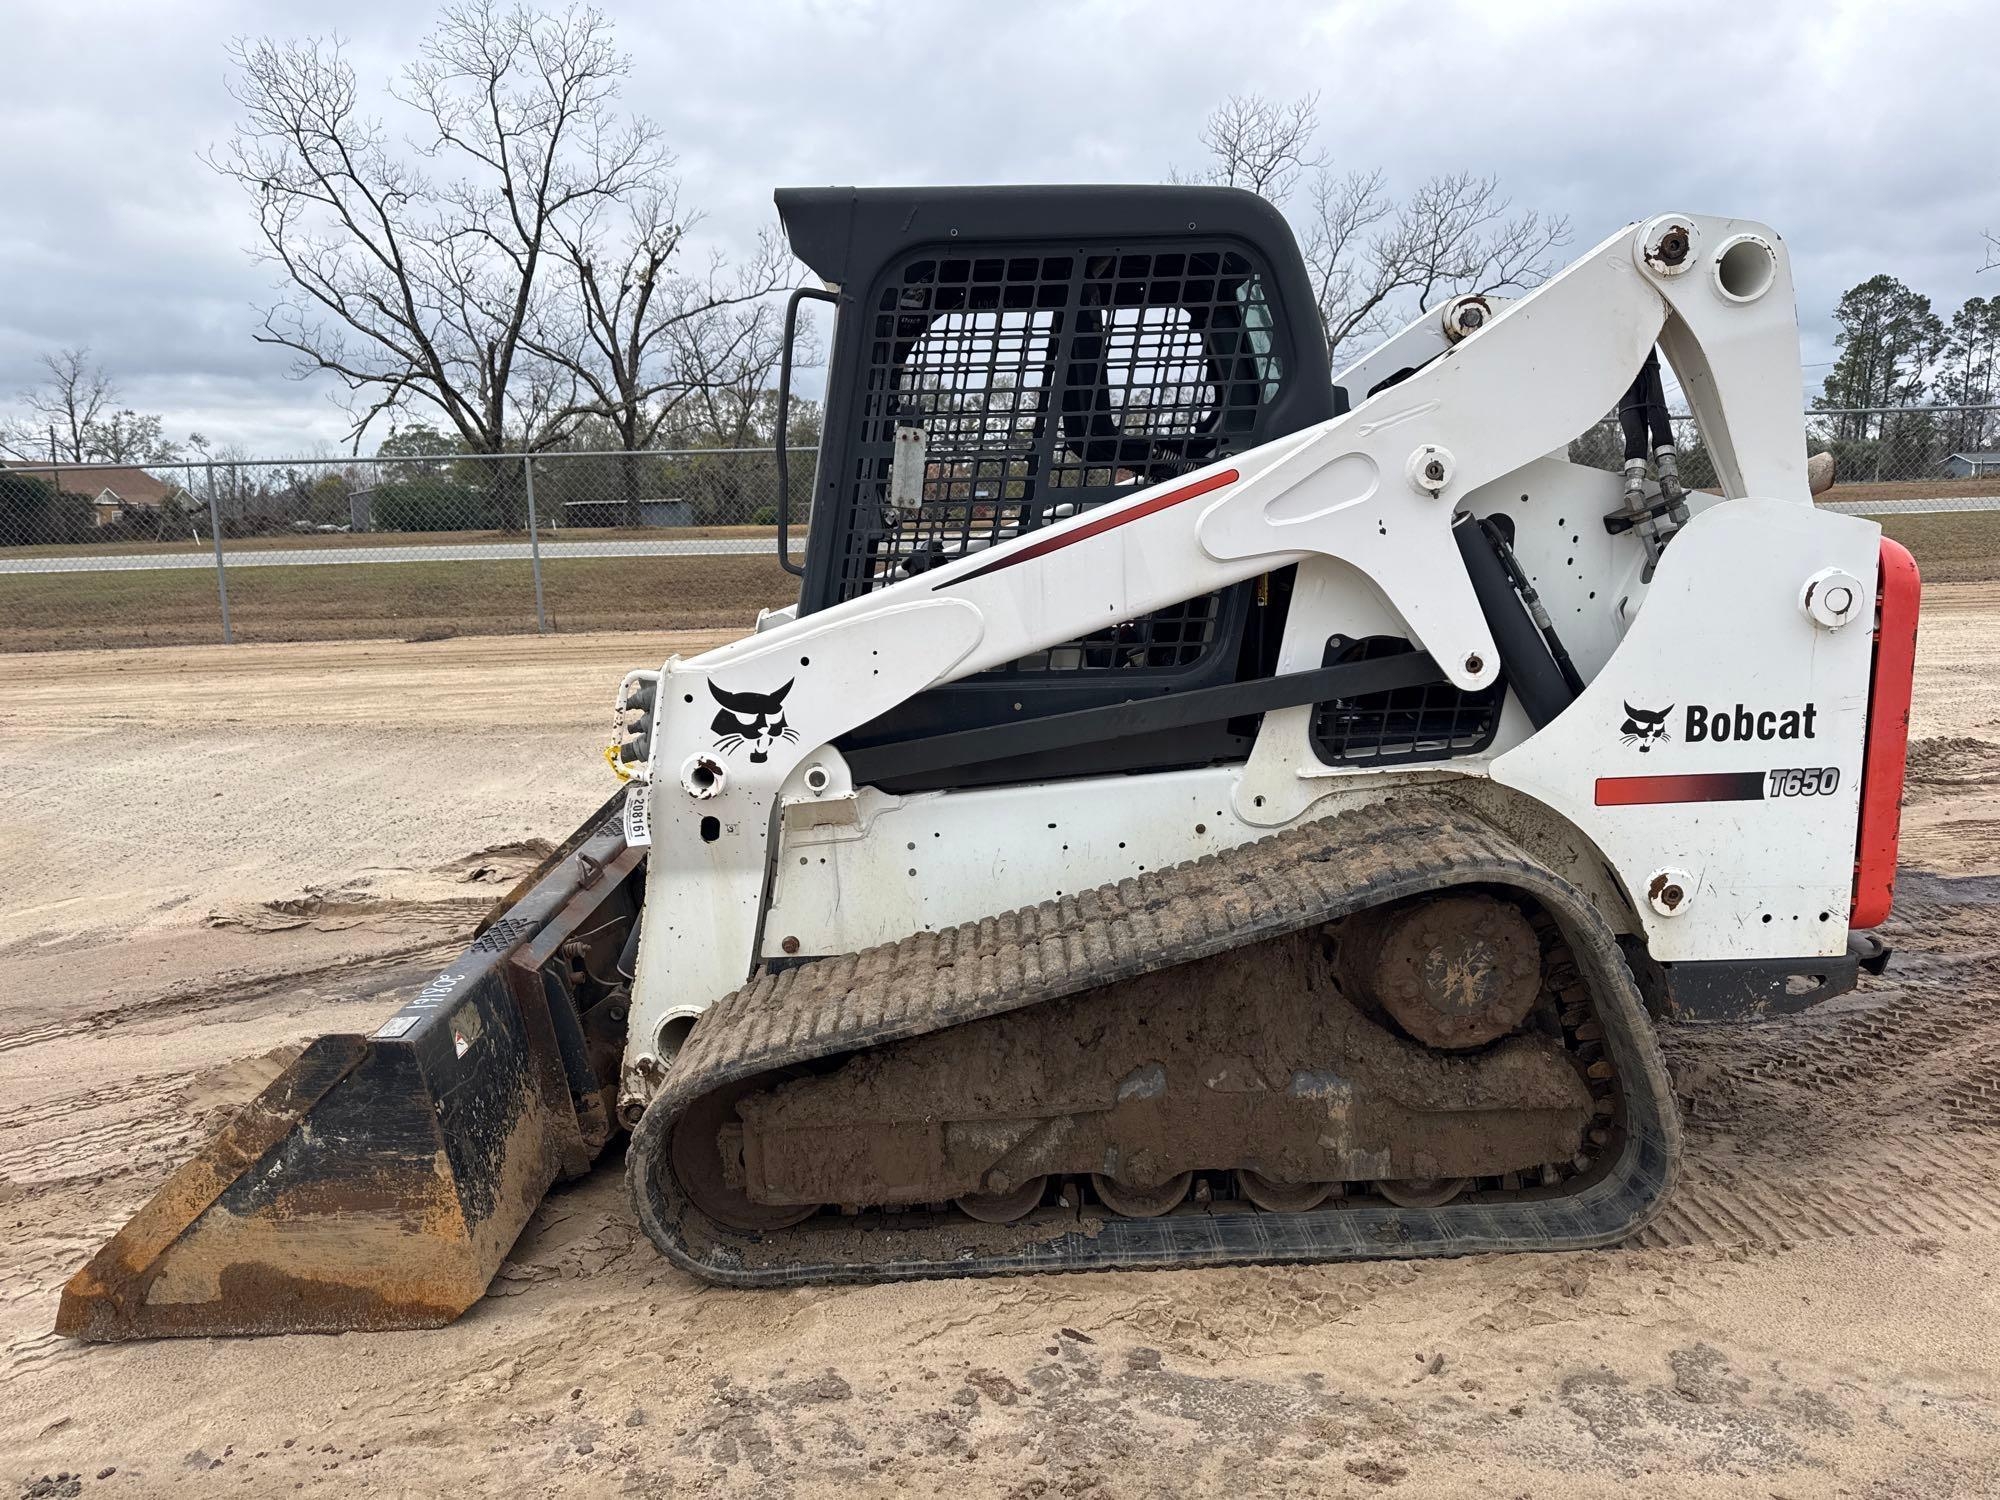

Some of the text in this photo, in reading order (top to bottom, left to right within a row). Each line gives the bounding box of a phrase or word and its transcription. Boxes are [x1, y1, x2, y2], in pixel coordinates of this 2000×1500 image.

[1685, 703, 1817, 742] Bobcat
[1769, 767, 1840, 798] T650
[632, 798, 646, 838] 208161
[406, 974, 466, 1009] 208161
